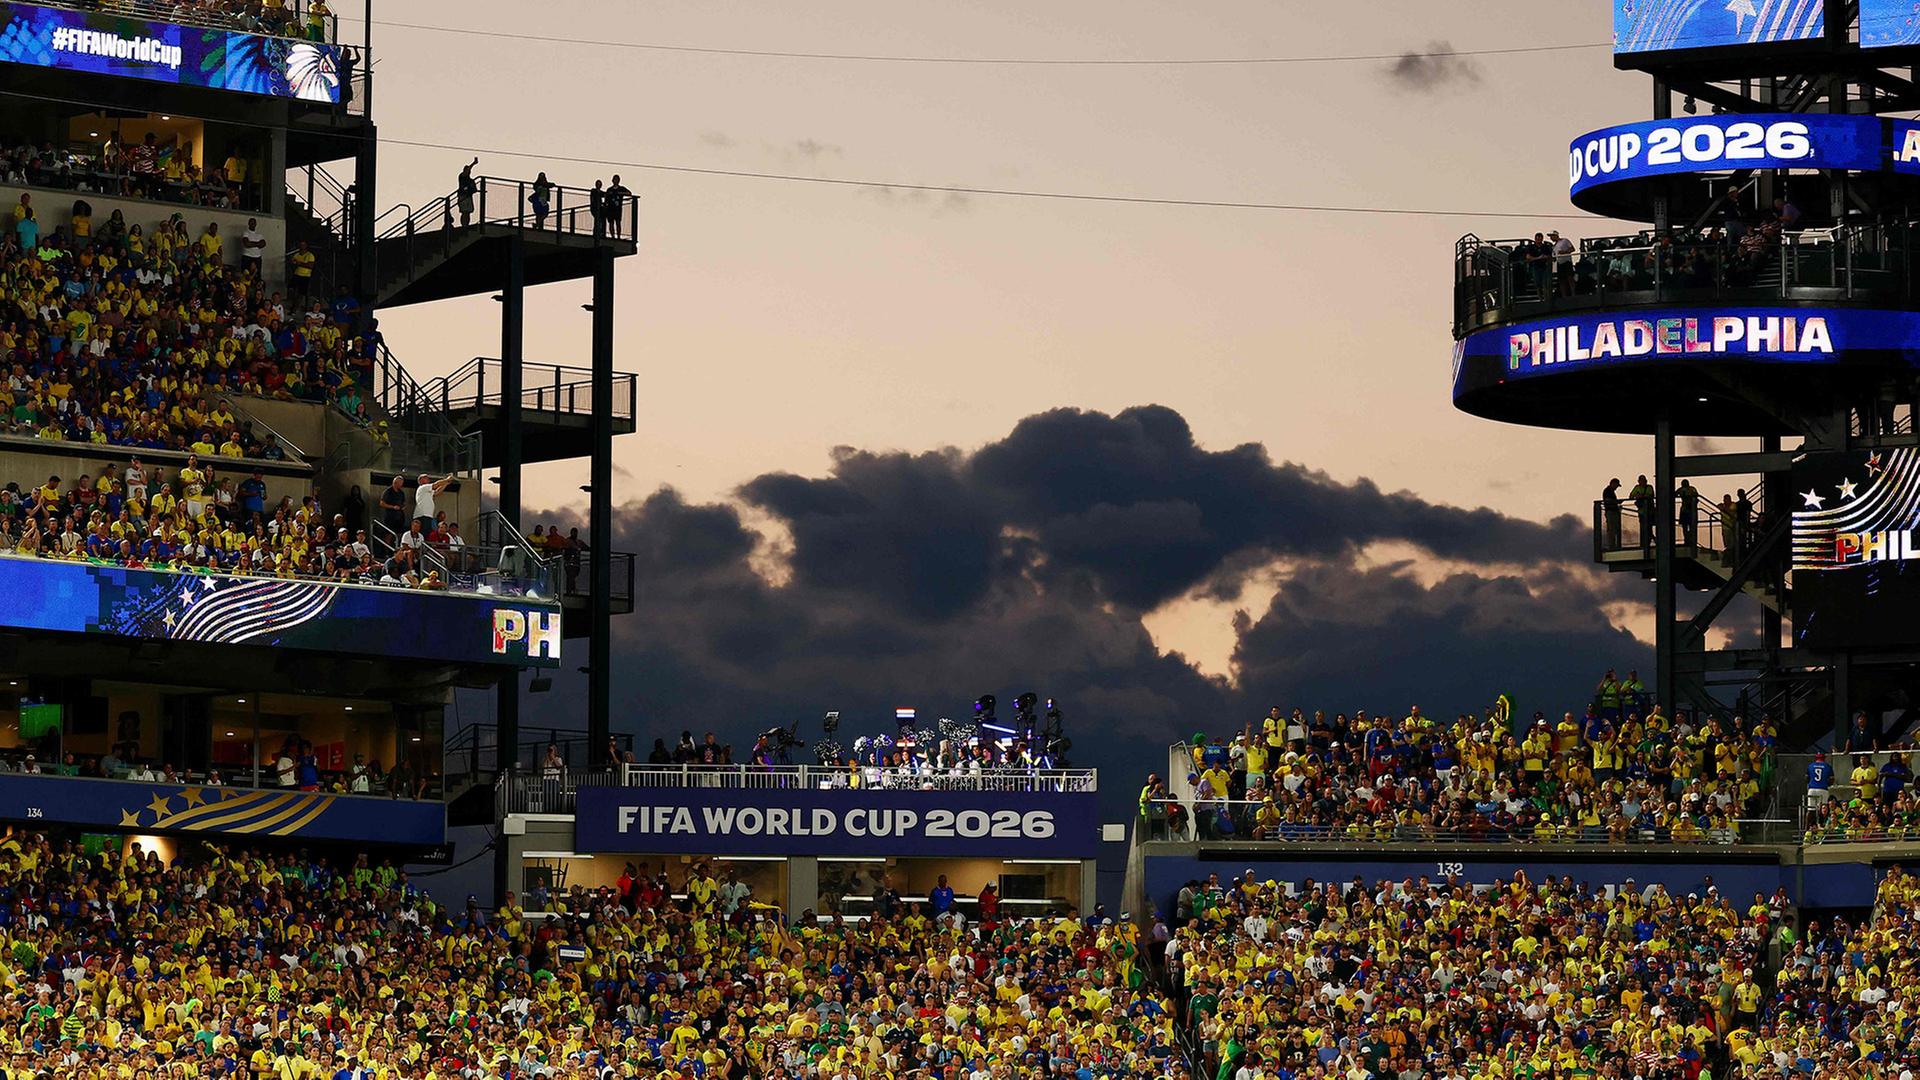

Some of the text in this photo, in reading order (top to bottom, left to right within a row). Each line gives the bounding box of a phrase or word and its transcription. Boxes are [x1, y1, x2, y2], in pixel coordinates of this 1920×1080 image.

[52, 27, 182, 69] #FIFAWorldCup
[1585, 133, 1641, 177] CUP
[1647, 121, 1810, 165] 2026
[1508, 316, 1834, 370] PHILADELPHIA
[1835, 530, 1920, 563] PHIL
[493, 608, 561, 659] PH
[27, 807, 43, 818] 134
[618, 806, 1055, 838] FIFA WORLD CUP 2026
[1437, 862, 1464, 876] 132
